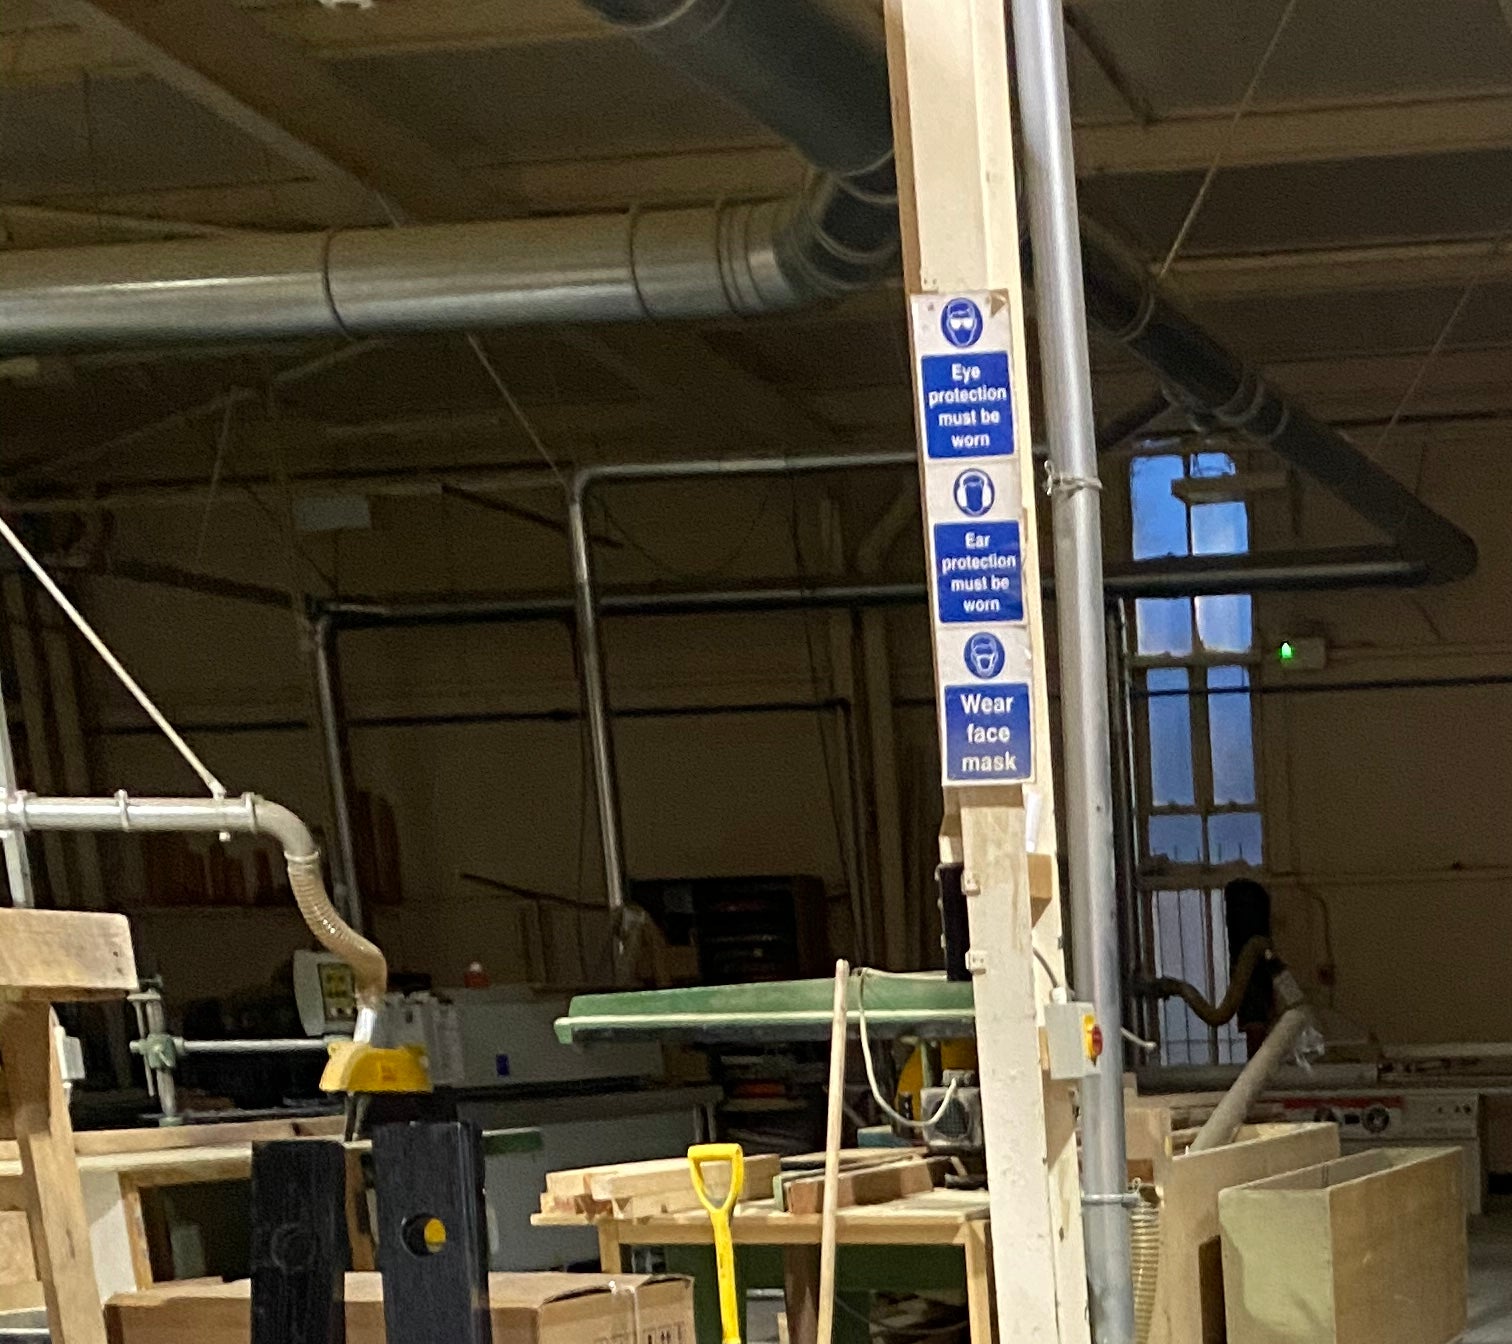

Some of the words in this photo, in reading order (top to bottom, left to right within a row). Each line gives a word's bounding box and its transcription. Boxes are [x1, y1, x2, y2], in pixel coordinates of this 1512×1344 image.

[952, 364, 980, 383] Eye
[929, 386, 1006, 408] protection
[939, 410, 976, 426] must
[982, 409, 999, 423] be
[952, 434, 990, 448] worn
[965, 532, 990, 549] Ear
[942, 554, 1016, 575] protection
[951, 576, 987, 591] must
[992, 575, 1009, 590] be
[964, 599, 1000, 612] worn
[961, 694, 1013, 714] Wear
[967, 724, 1010, 744] face
[962, 752, 1017, 771] mask
